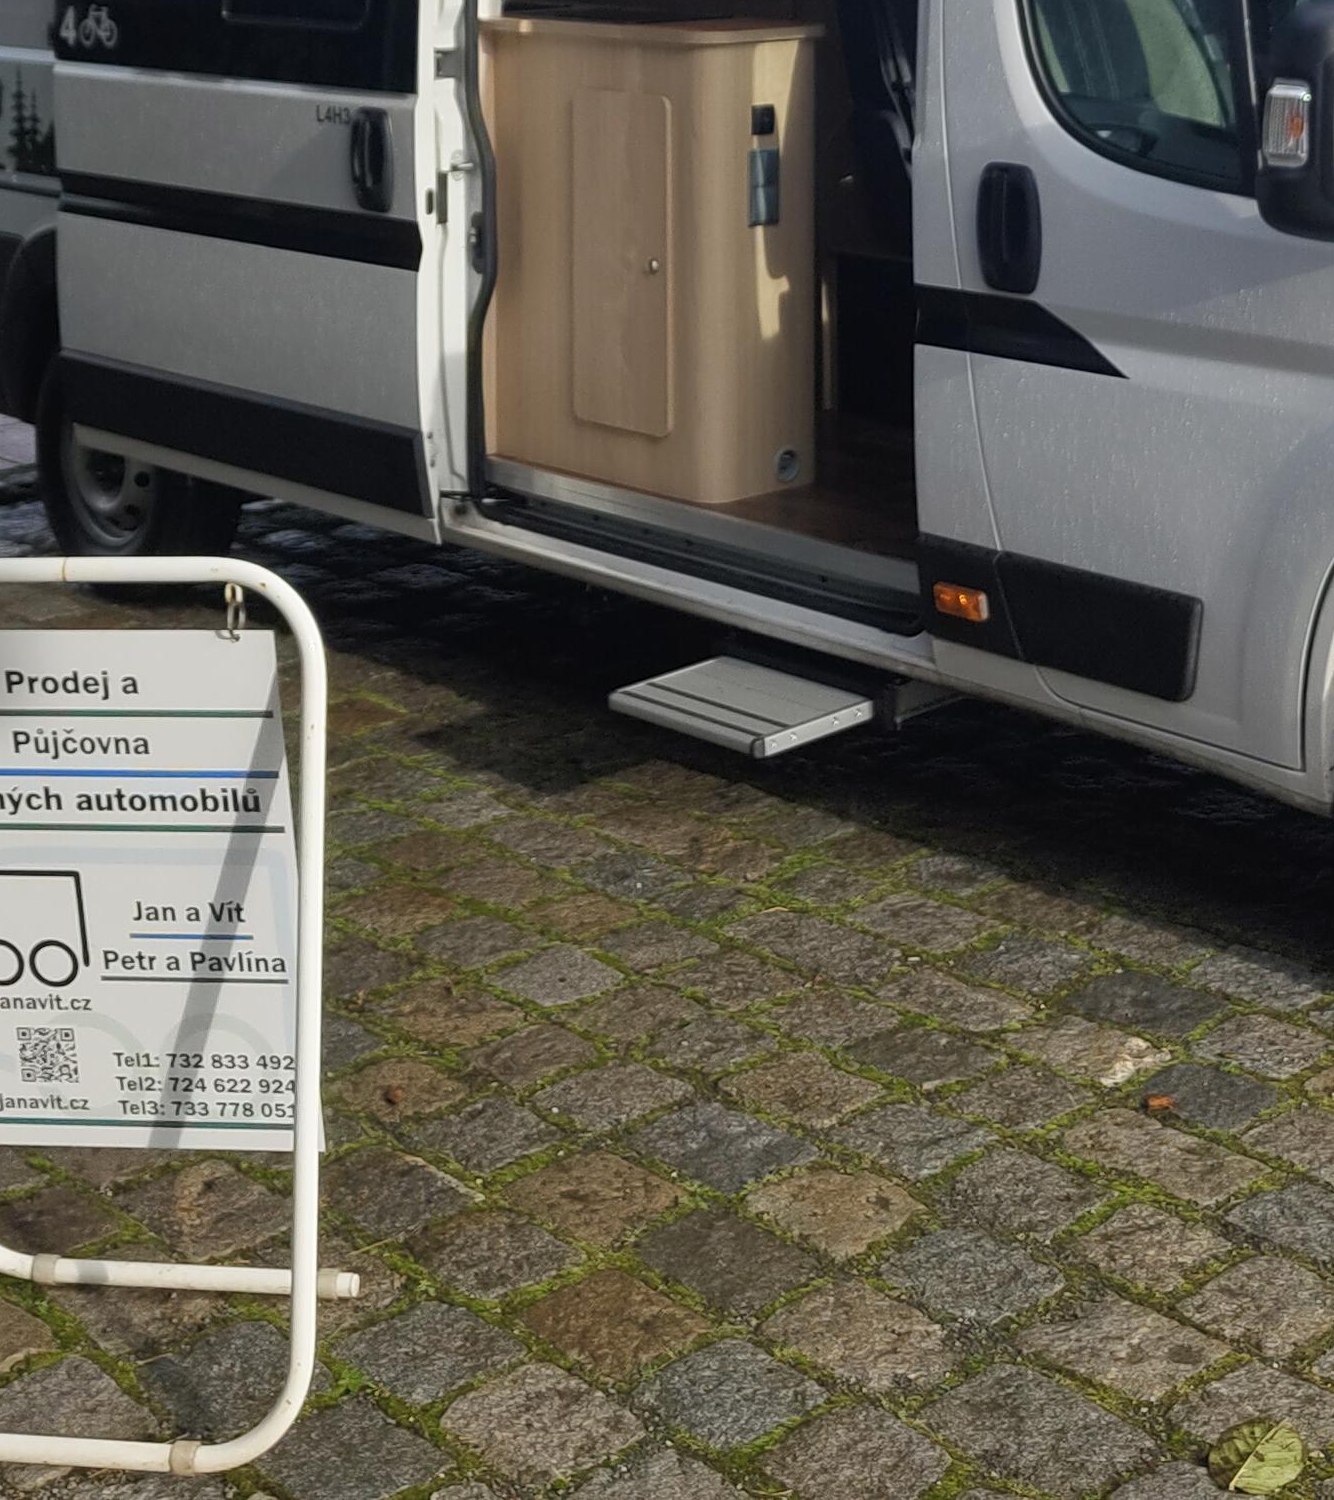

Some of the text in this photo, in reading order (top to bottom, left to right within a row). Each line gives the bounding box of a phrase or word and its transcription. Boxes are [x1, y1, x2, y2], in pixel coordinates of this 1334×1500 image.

[59, 5, 77, 45] 4
[4, 669, 140, 700] Prodej a
[12, 727, 151, 760] Půjčovna
[75, 787, 262, 813] automobilů
[132, 901, 246, 923] Jan a Vít
[102, 949, 287, 973] Petr a Pavlína
[113, 1052, 295, 1070] Tel1: 732 833 492
[115, 1076, 296, 1094] Tel2: 724 622 924
[117, 1100, 166, 1117] Tel3:
[170, 1100, 210, 1117] 733
[215, 1101, 255, 1118] 778
